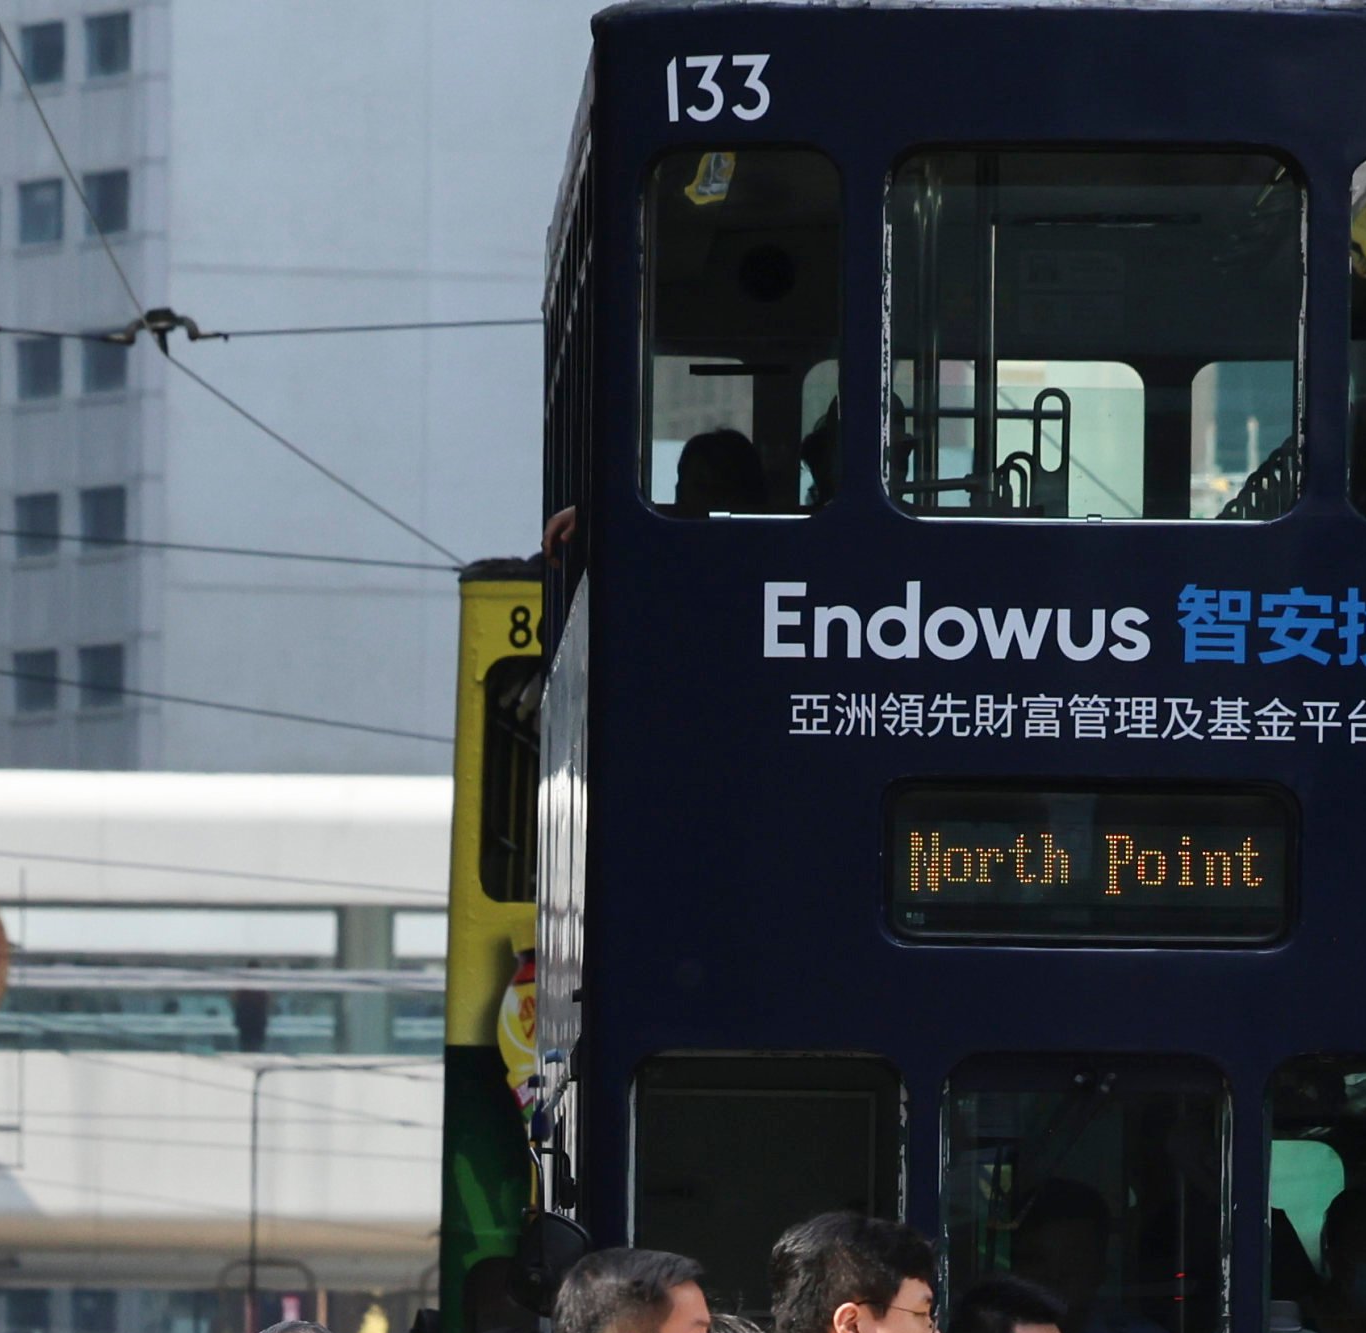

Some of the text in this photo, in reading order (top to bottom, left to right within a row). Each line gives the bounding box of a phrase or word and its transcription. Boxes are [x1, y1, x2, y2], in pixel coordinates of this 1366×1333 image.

[666, 54, 771, 122] 133
[763, 581, 1151, 662] Endowus
[909, 831, 1265, 896] North Point
